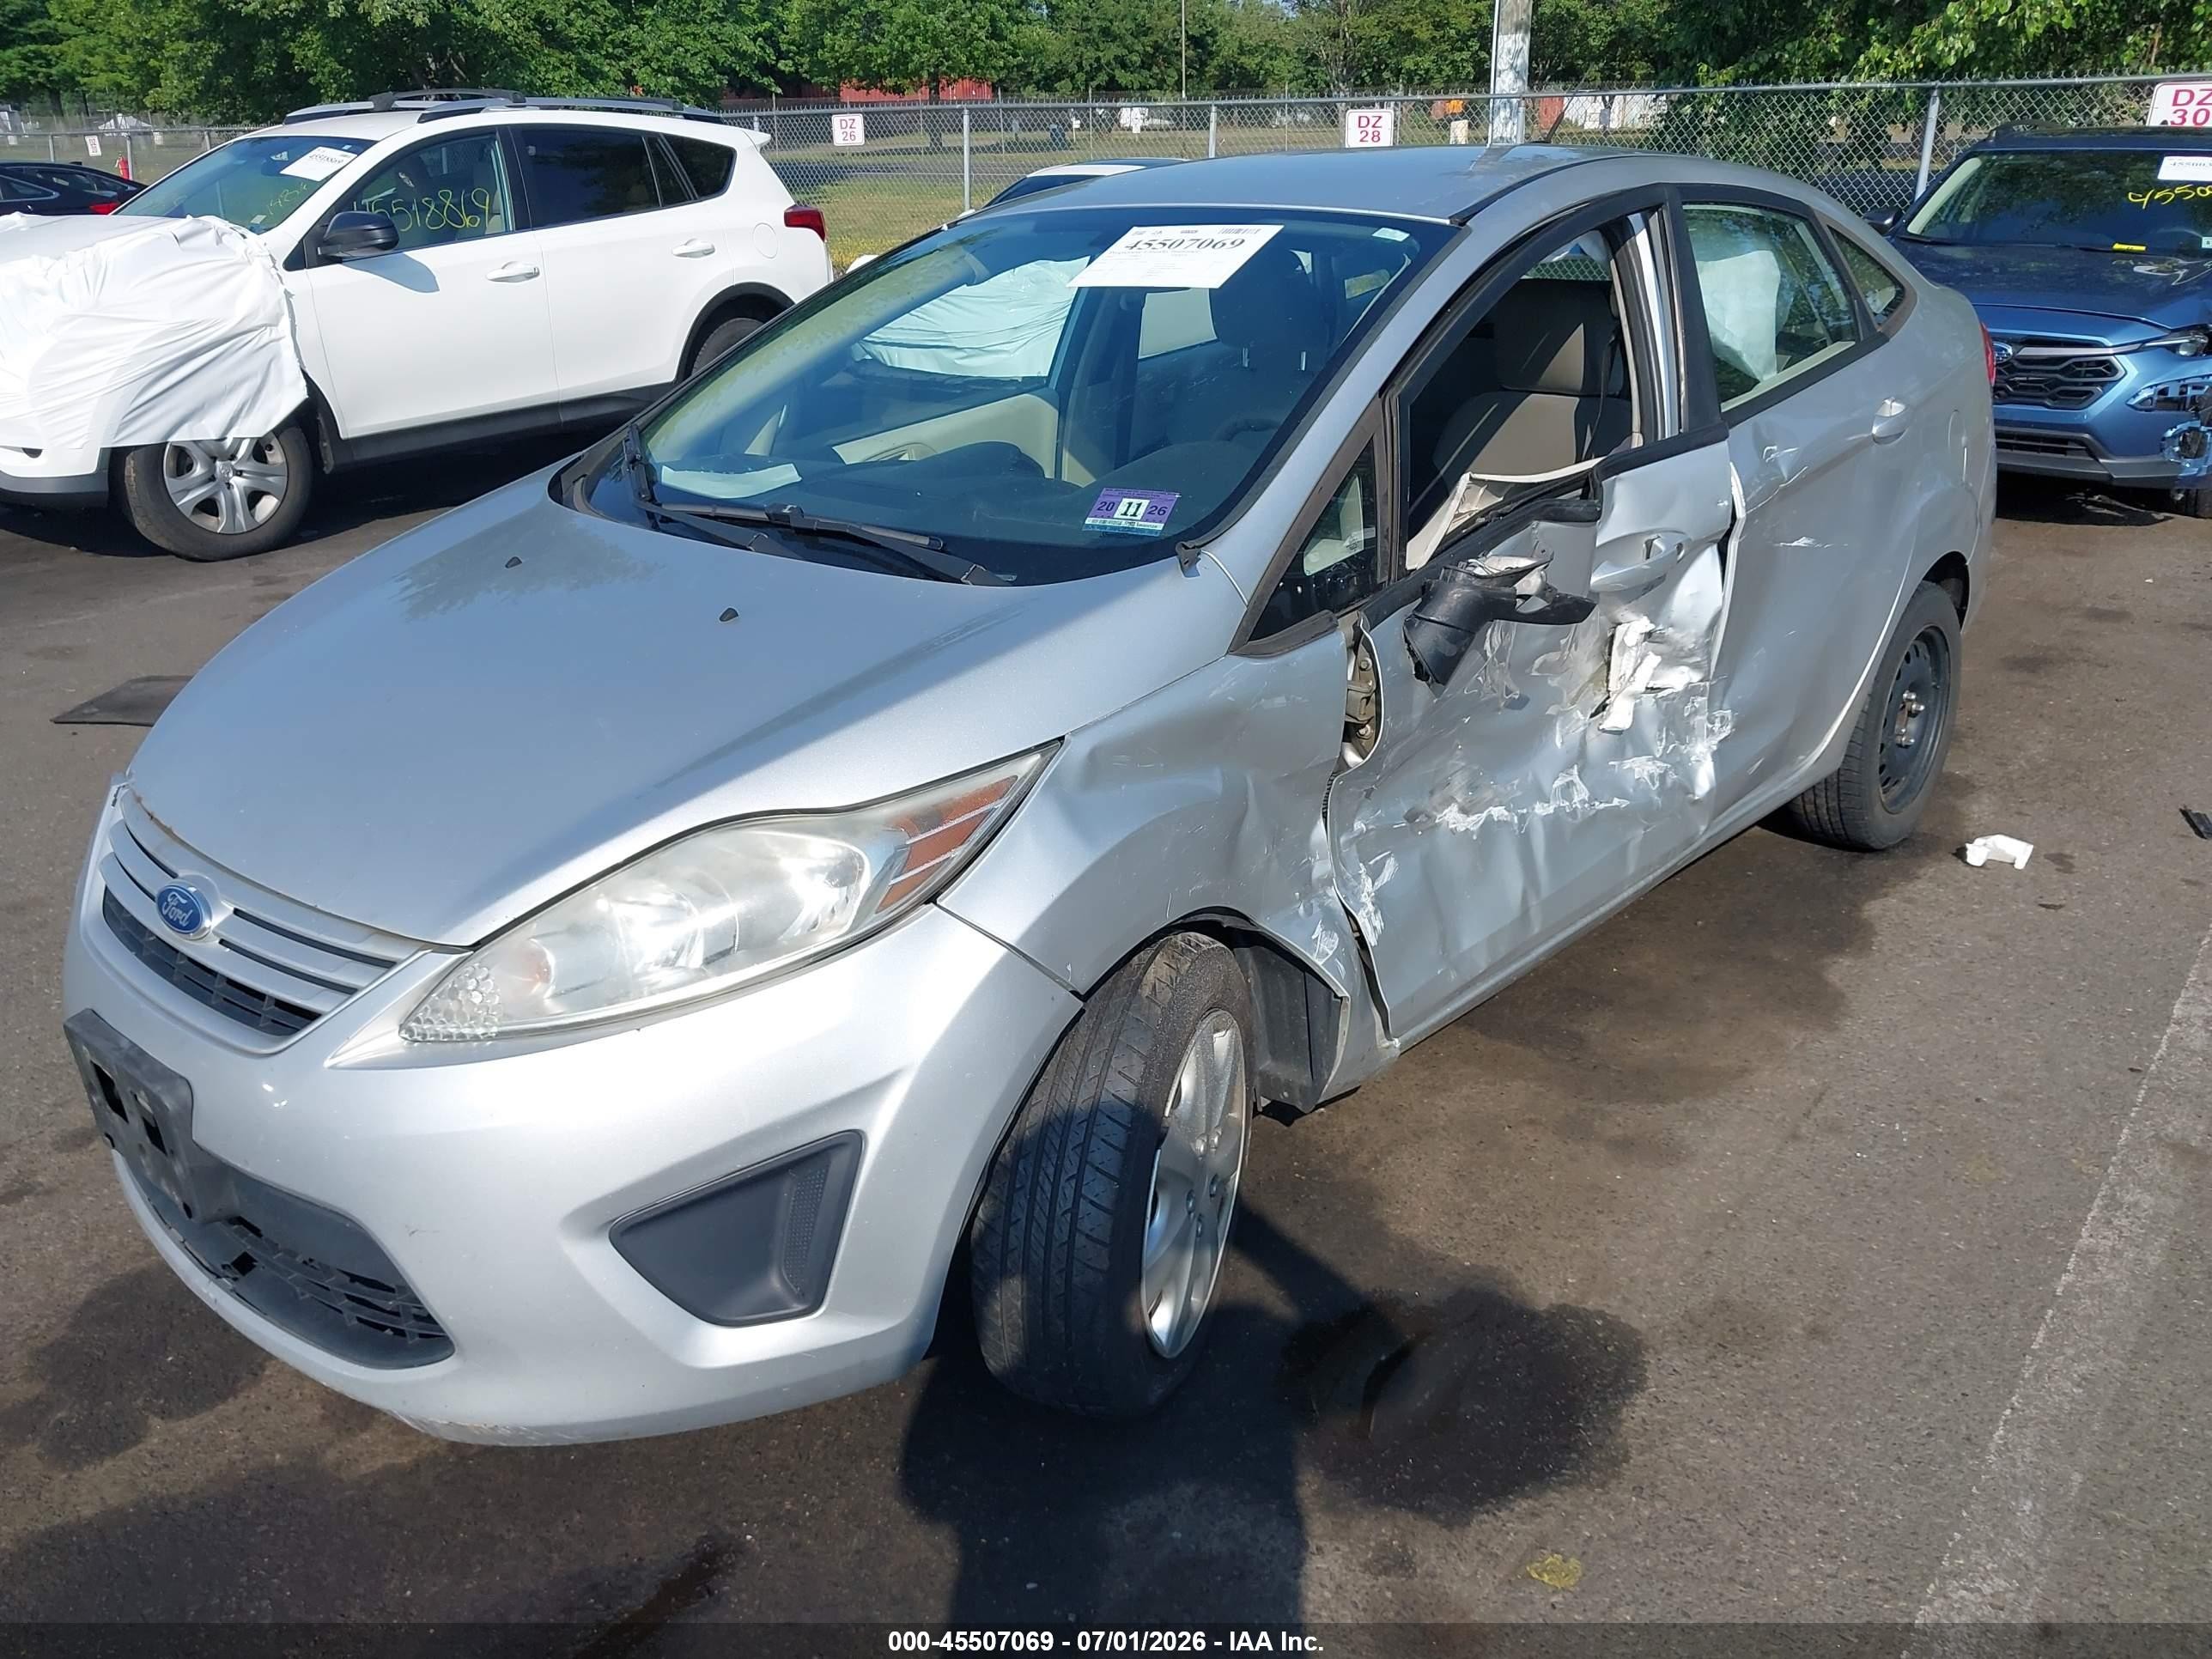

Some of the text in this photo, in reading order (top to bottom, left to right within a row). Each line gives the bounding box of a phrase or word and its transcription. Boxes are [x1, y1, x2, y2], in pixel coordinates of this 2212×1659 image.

[2172, 88, 2212, 106] DZ
[840, 118, 856, 129] DZ
[1358, 115, 1382, 128] DZ
[2170, 108, 2210, 126] 30
[842, 131, 856, 141] 26
[1359, 130, 1381, 143] 28
[1124, 237, 1245, 250] 45507069
[1097, 501, 1168, 517] 20 11 26
[162, 891, 193, 927] Ford
